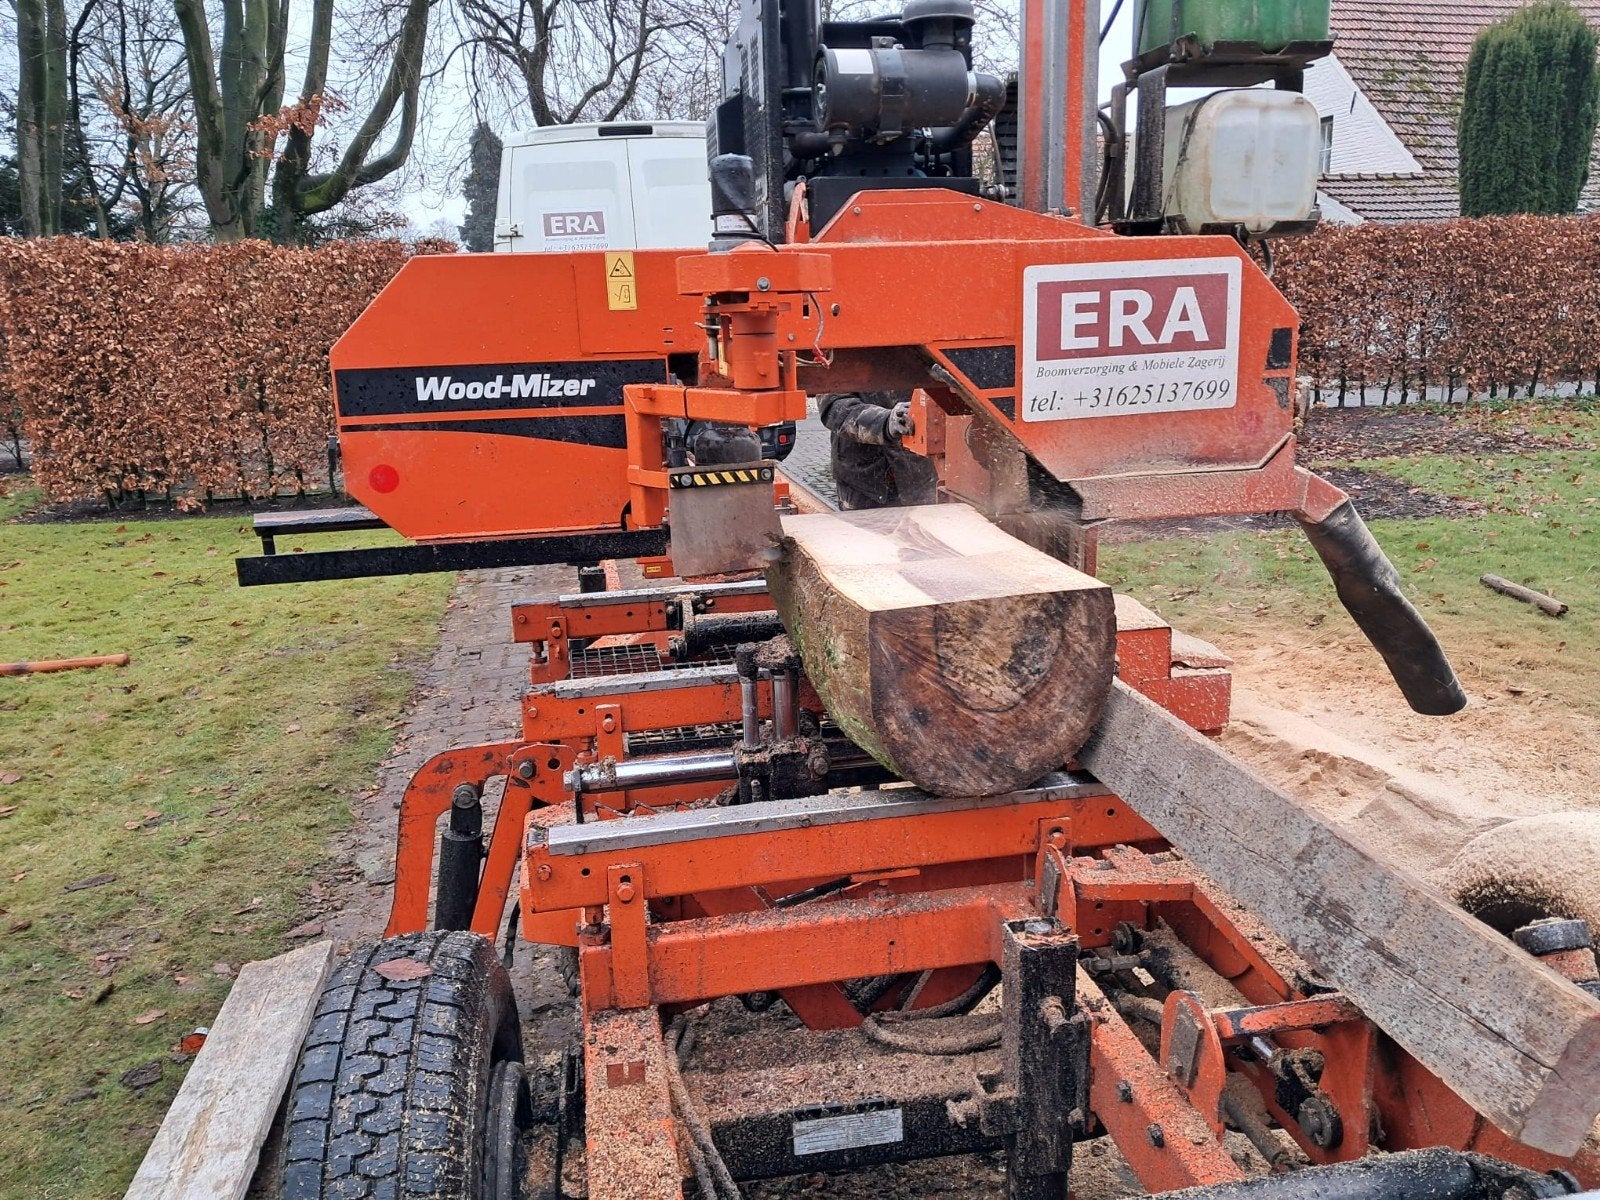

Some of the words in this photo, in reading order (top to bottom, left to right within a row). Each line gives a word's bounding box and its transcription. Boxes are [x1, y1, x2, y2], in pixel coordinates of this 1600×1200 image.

[550, 215, 600, 234] ERA
[1060, 286, 1210, 350] ERA
[1036, 363, 1125, 378] Boomverzorging
[1129, 361, 1138, 371] &
[1142, 359, 1185, 371] Mobiele
[1187, 356, 1226, 369] Zagerij
[415, 373, 596, 401] Wood-Mizer
[1030, 390, 1064, 413] tel:
[1073, 378, 1231, 408] +31625137699
